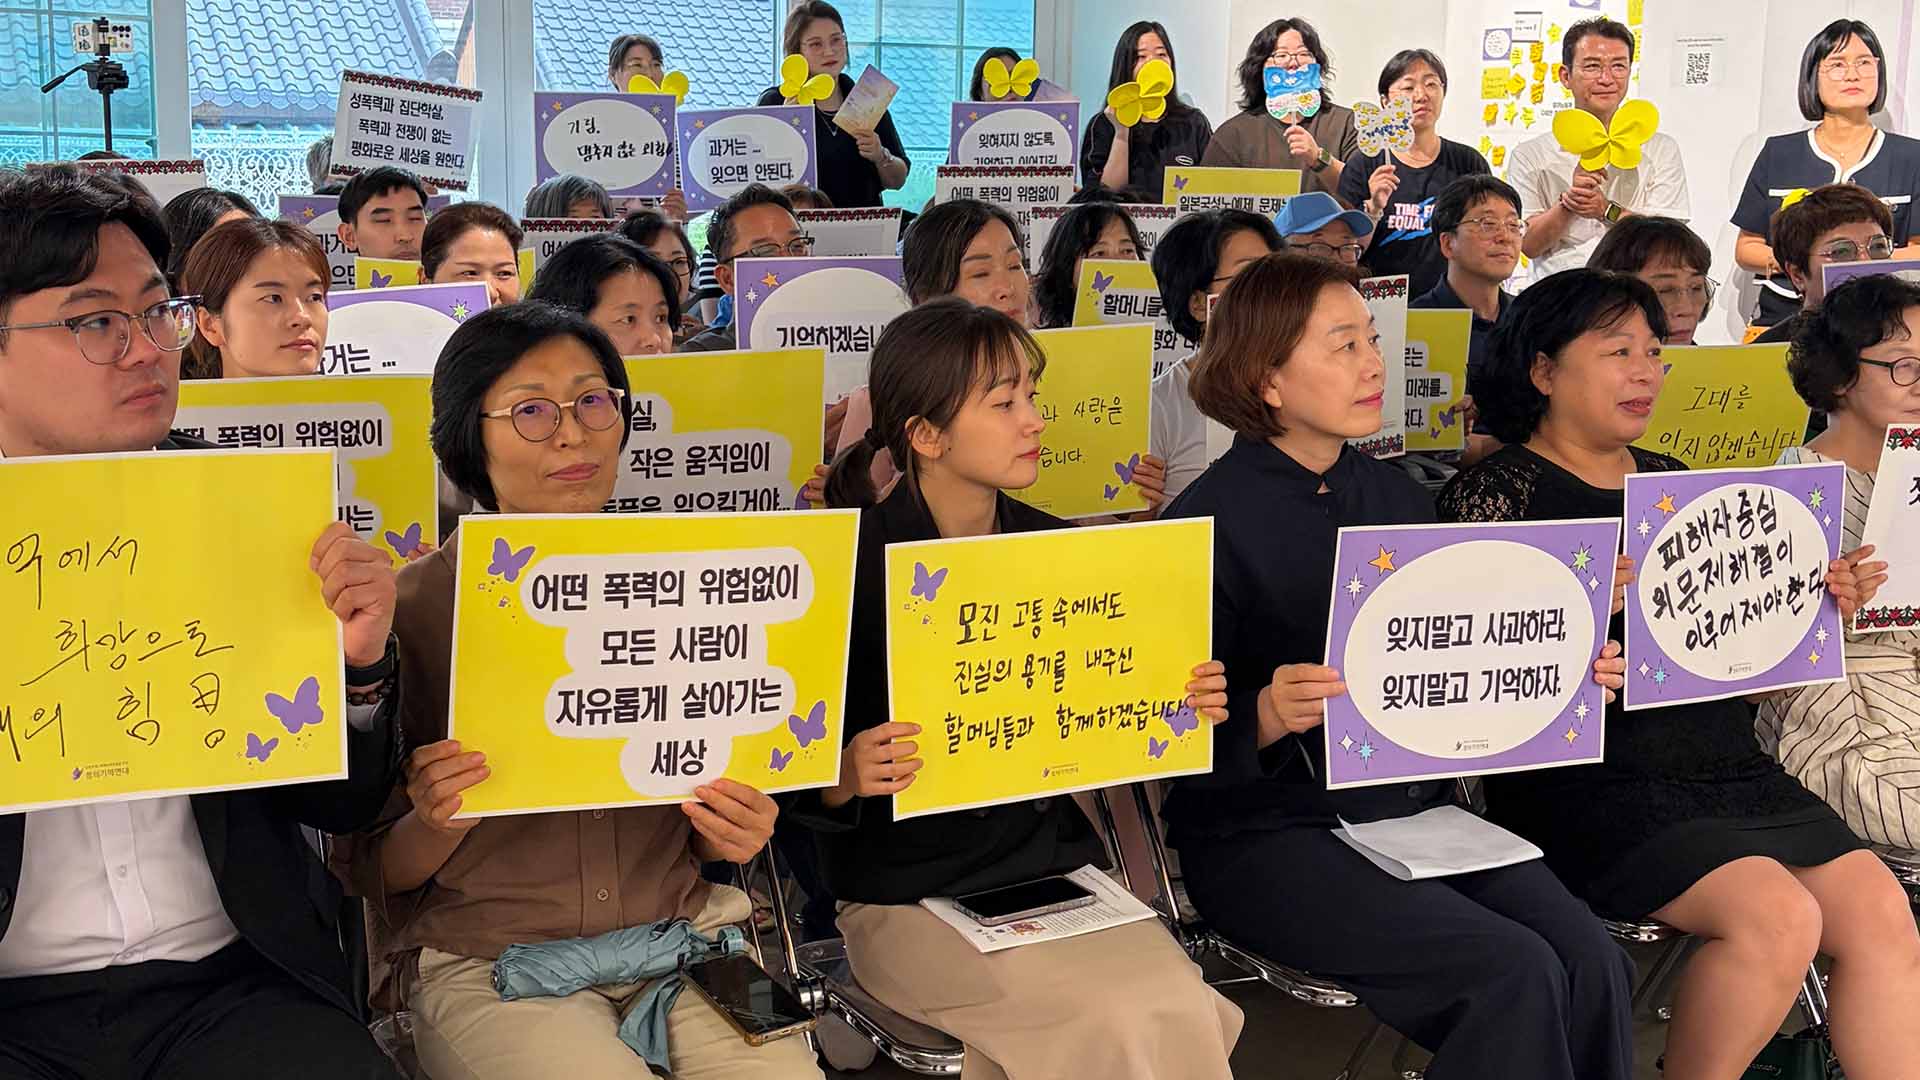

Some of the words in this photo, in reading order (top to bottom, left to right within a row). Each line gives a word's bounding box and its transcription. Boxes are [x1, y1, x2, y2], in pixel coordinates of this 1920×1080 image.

[350, 92, 394, 114] 성폭력과
[399, 99, 444, 121] 집단학살,
[358, 118, 391, 137] 폭력과
[396, 123, 427, 142] 전쟁이
[431, 128, 452, 145] 없는
[708, 138, 747, 158] 과거는
[979, 133, 1019, 149] 잊혀지지
[351, 140, 394, 161] 평화로운
[399, 146, 430, 165] 세상을
[435, 151, 465, 170] 원한다.
[711, 164, 748, 184] 잊으면
[754, 162, 794, 181] 안된다.
[1016, 185, 1060, 202] 위험없이
[1394, 203, 1420, 217] TIME
[1074, 396, 1122, 425] 사랑은
[295, 418, 383, 447] 위험없이
[630, 447, 674, 479] 작은
[685, 441, 770, 476] 움직임이
[1657, 499, 1732, 571] 피해자
[1736, 489, 1778, 540] 중심
[531, 573, 588, 612] 어떤
[602, 568, 685, 609] 폭력의
[699, 564, 799, 604] 위험없이
[956, 602, 1000, 645] 모진
[1012, 598, 1045, 639] 고통
[1386, 614, 1473, 652] 잊지말고
[1482, 608, 1567, 647] 사과하라,
[601, 628, 656, 667] 모든
[669, 623, 748, 662] 사람이
[953, 659, 1012, 696] 진실의
[1021, 650, 1066, 693] 용기를
[1085, 646, 1135, 677] 내주신
[1382, 672, 1469, 711] 잊지말고
[1479, 664, 1561, 704] 기억하자.
[555, 684, 668, 726] 자유롭게
[681, 678, 782, 717] 살아가는
[650, 739, 707, 777] 세상
